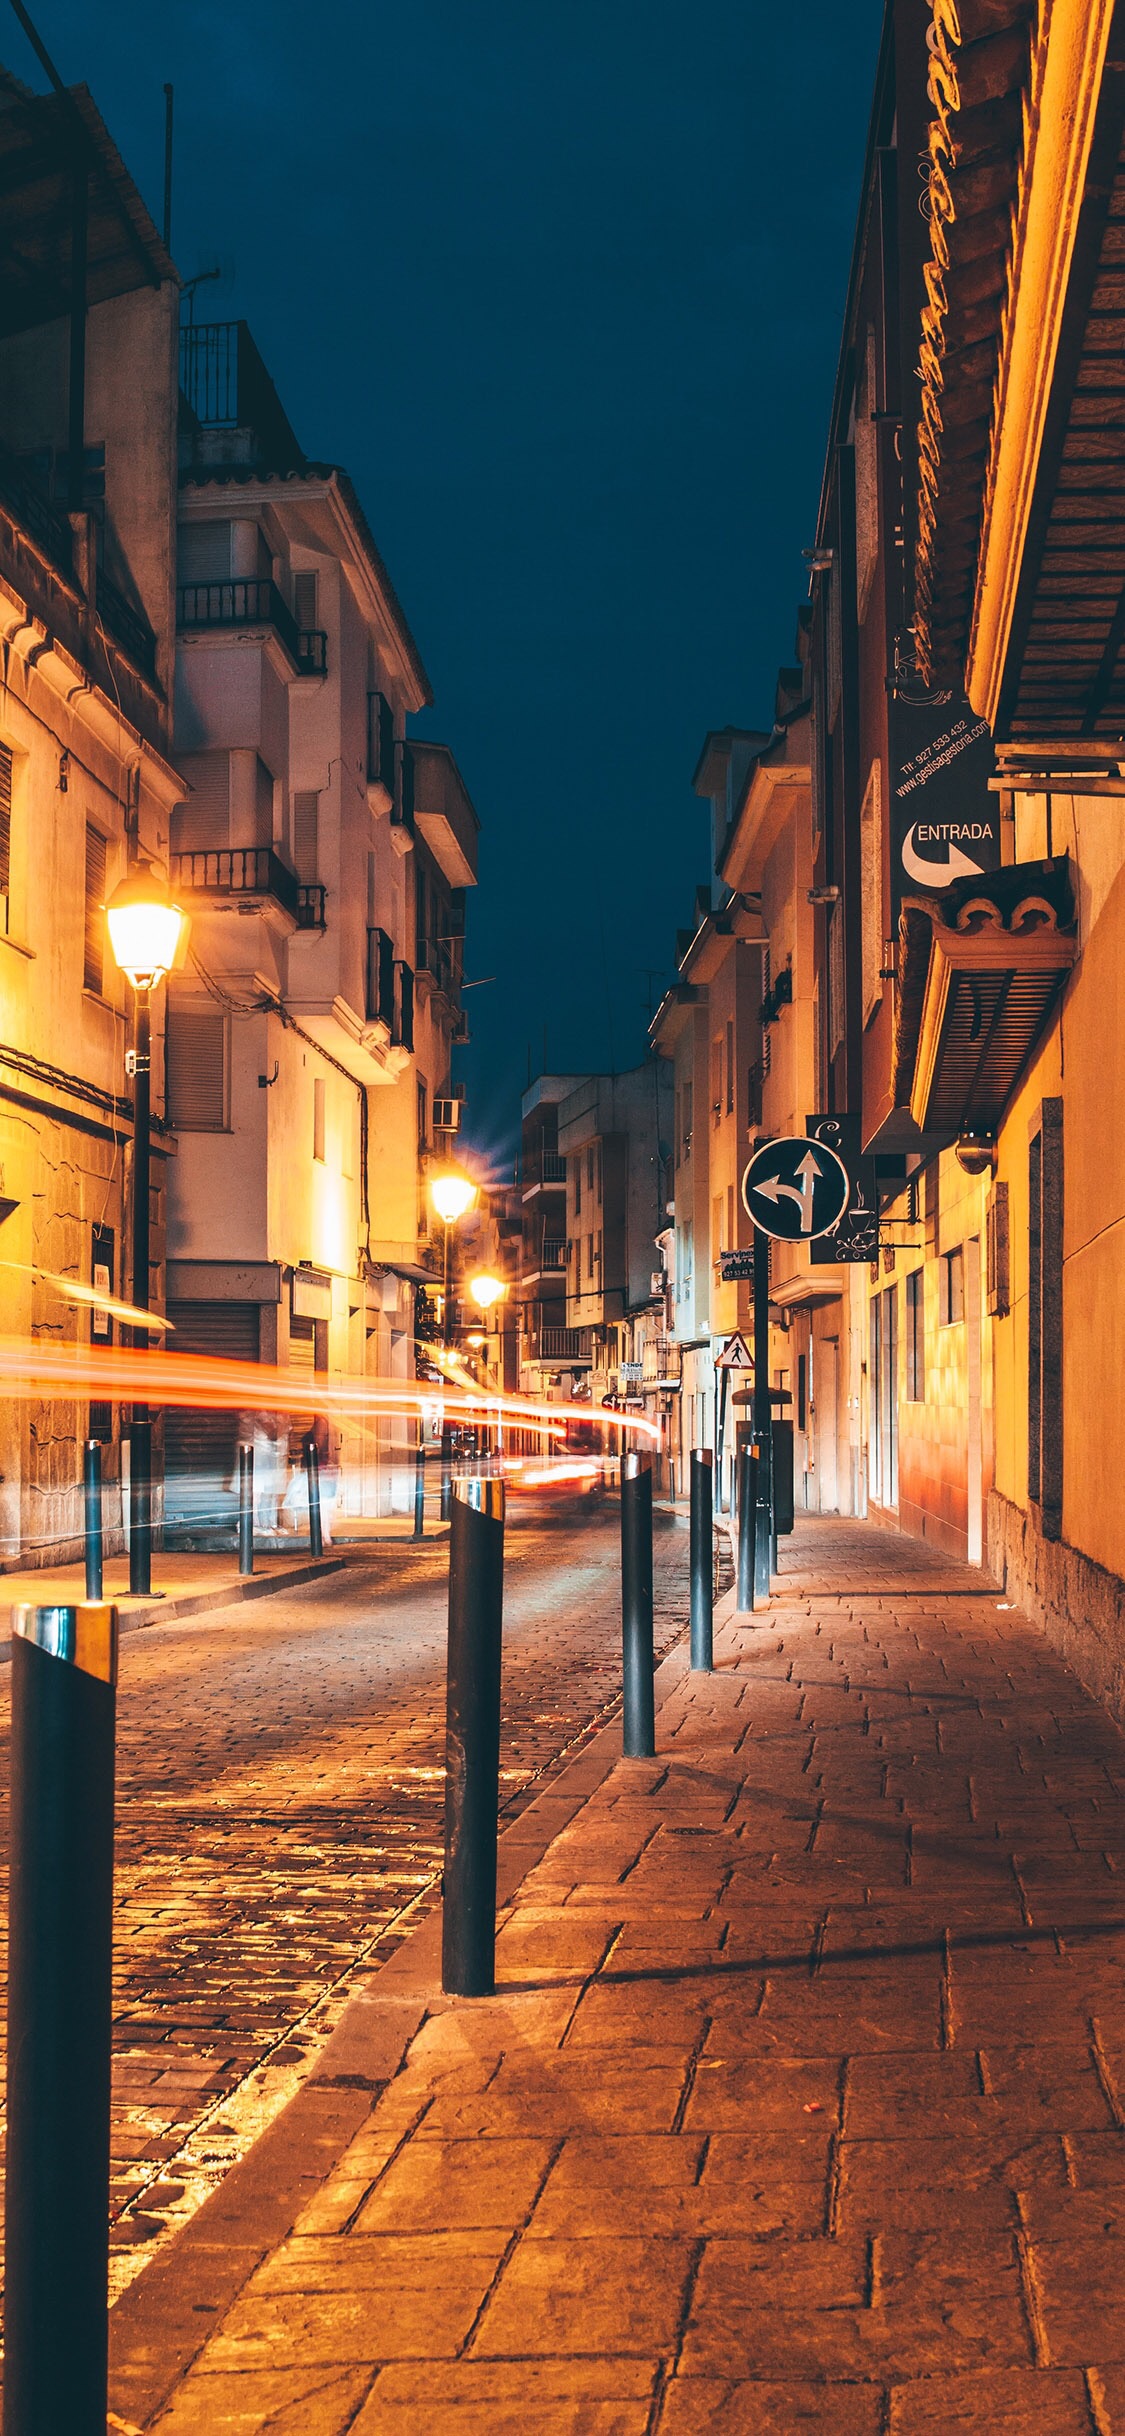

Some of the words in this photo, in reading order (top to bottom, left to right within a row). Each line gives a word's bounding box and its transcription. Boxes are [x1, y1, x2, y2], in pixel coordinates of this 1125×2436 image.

[895, 719, 990, 798] www.gestisagestoria.com
[915, 747, 932, 764] 927
[932, 734, 951, 751] 533
[950, 720, 968, 736] 432
[917, 823, 993, 841] ENTRADA
